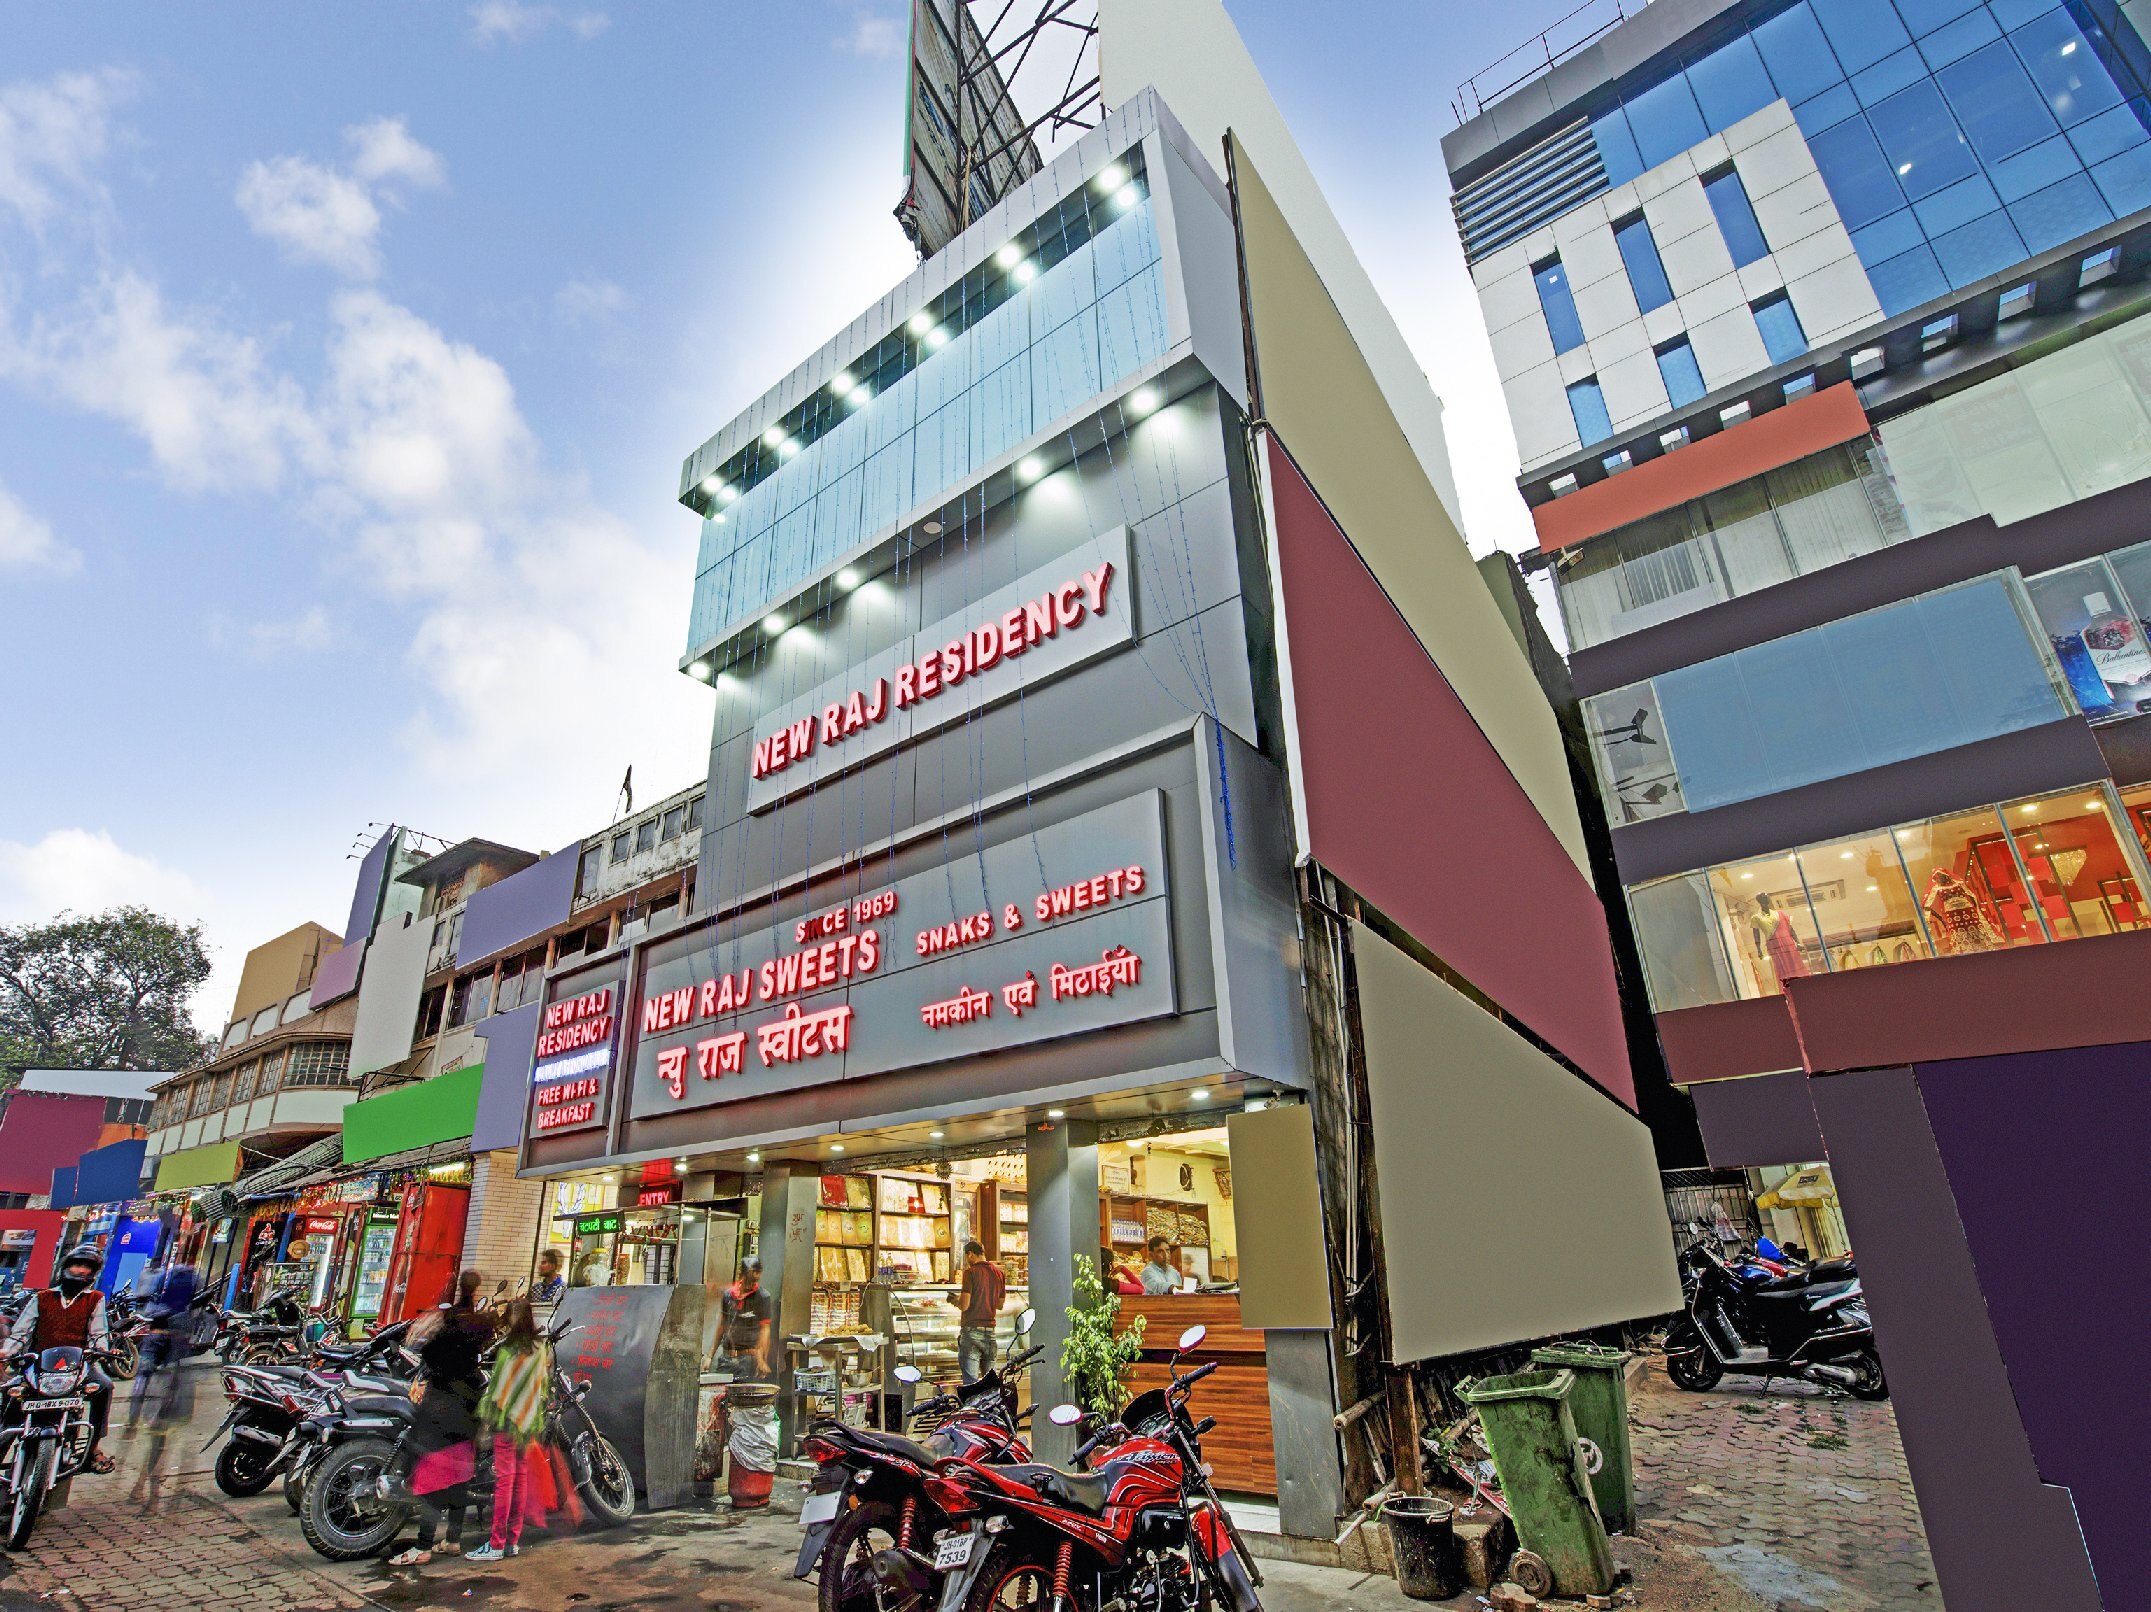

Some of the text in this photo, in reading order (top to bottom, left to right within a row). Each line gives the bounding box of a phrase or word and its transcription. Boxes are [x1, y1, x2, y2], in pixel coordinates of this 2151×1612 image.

[752, 561, 1113, 779] NEW RAJ RESIDENCY
[795, 890, 898, 944] SINCE 1969
[916, 865, 1145, 957] SNAKS & SWEETS
[643, 929, 879, 1032] NEW RAJ SWEETS
[921, 986, 993, 1029] नमकीन
[1002, 970, 1040, 1017] एवं
[546, 989, 611, 1028] NEW RAJ
[537, 1016, 612, 1058] RESIDENCY
[697, 1032, 748, 1080] राज
[538, 1086, 562, 1106] FREE
[588, 1078, 598, 1096] &
[538, 1102, 595, 1130] BREAKFAST
[639, 1190, 669, 1206] ENTRY
[939, 1550, 966, 1565] 7539
